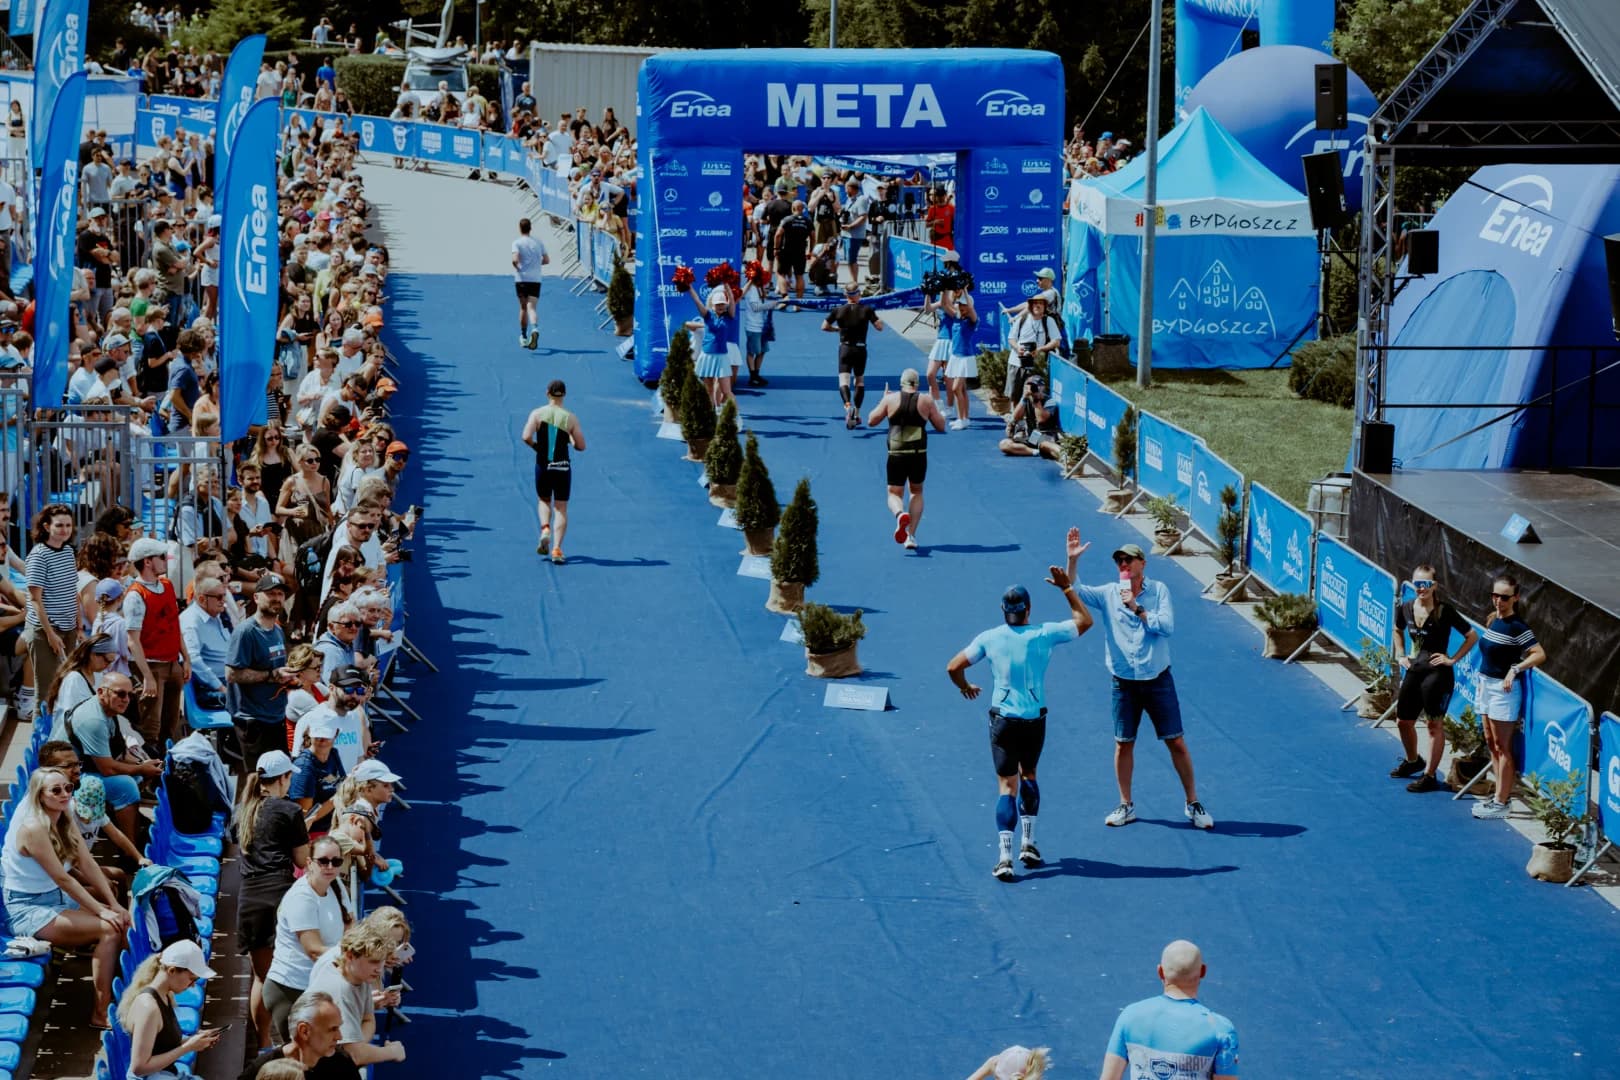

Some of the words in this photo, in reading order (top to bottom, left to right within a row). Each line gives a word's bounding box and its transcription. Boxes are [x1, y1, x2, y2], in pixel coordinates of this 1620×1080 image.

[59, 13, 79, 79] Enea
[670, 101, 731, 118] Enea
[767, 83, 946, 128] META
[985, 100, 1045, 116] Enea
[854, 160, 877, 170] Enea
[1189, 213, 1298, 230] BYDGOSZCZ
[1480, 198, 1552, 257] Enea
[245, 184, 267, 295] Enea
[658, 255, 686, 265] GLS.
[979, 253, 1008, 263] GLS.
[980, 281, 1007, 289] SOLID
[1152, 318, 1269, 334] BYDGOSZCZ
[1548, 735, 1572, 772] Enea
